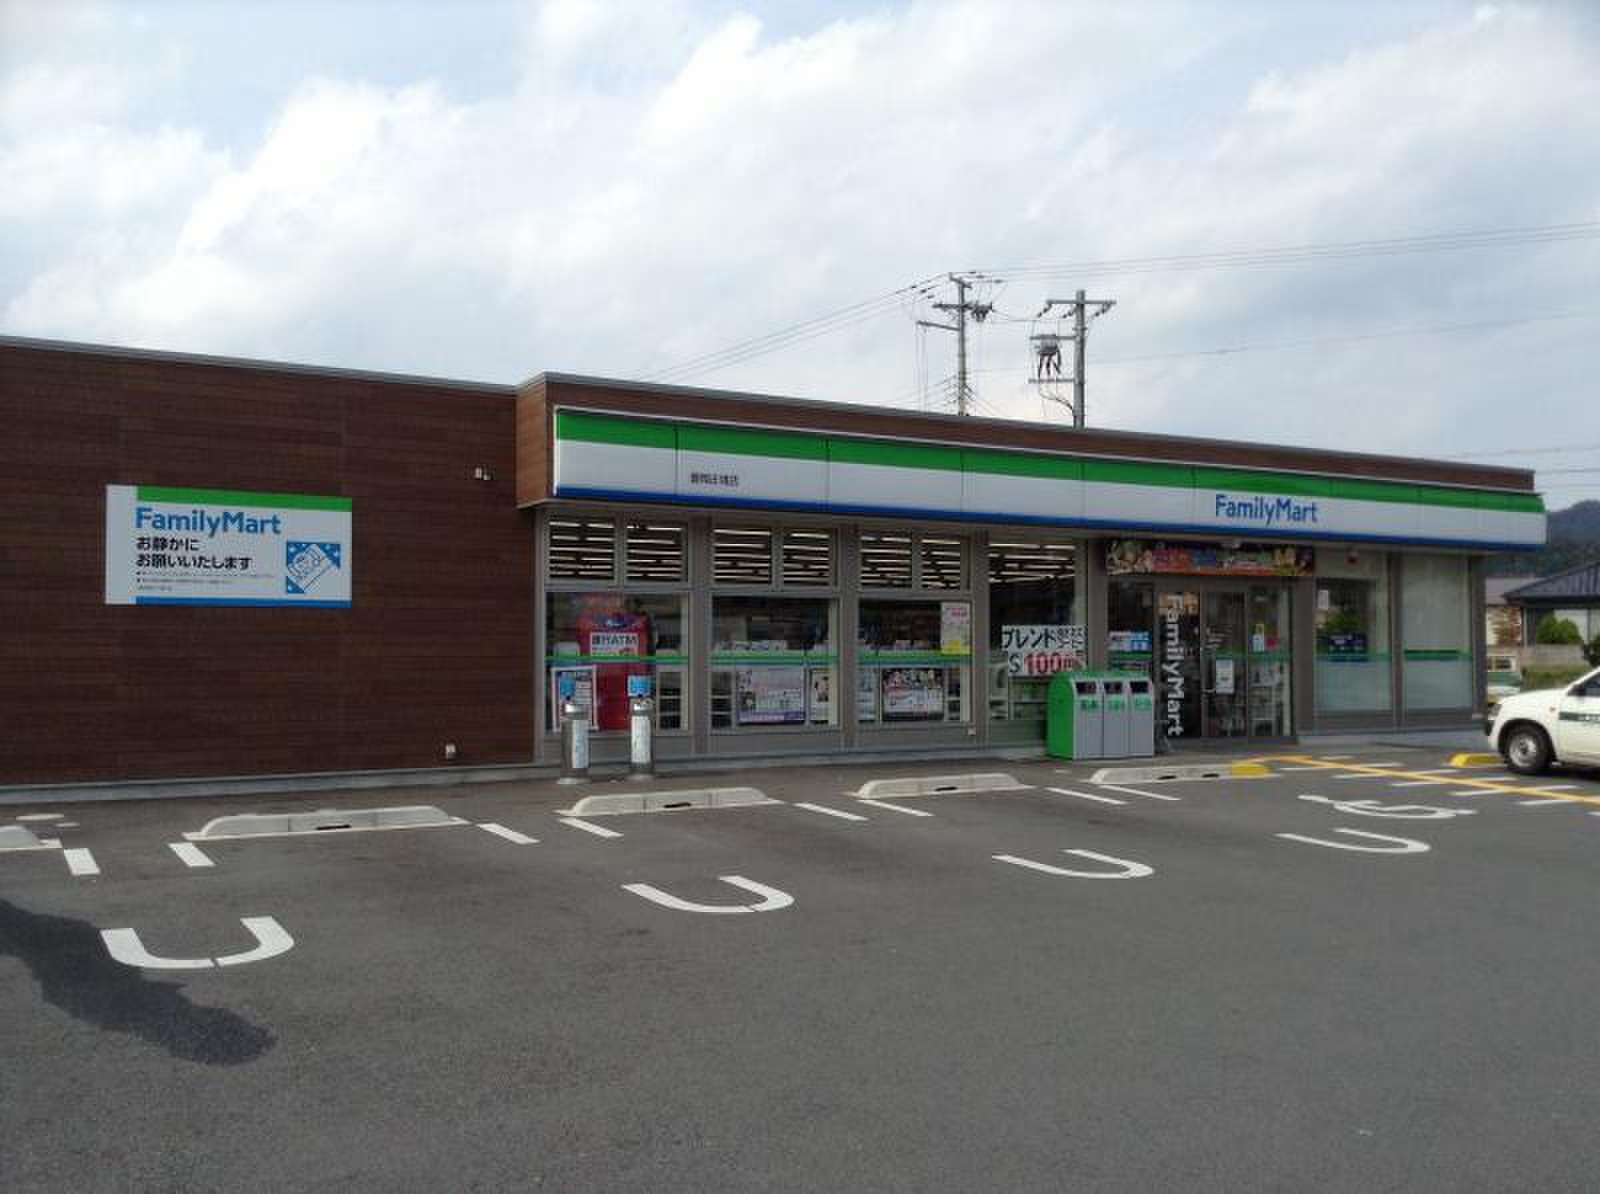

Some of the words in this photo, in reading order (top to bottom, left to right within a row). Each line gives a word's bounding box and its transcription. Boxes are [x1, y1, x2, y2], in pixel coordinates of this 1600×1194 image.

[136, 507, 281, 538] FamilyMart
[1215, 495, 1318, 525] FamilyMart
[136, 537, 200, 552] お静かに
[136, 554, 252, 570] お願いいたします
[1162, 594, 1184, 736] FamilyMart
